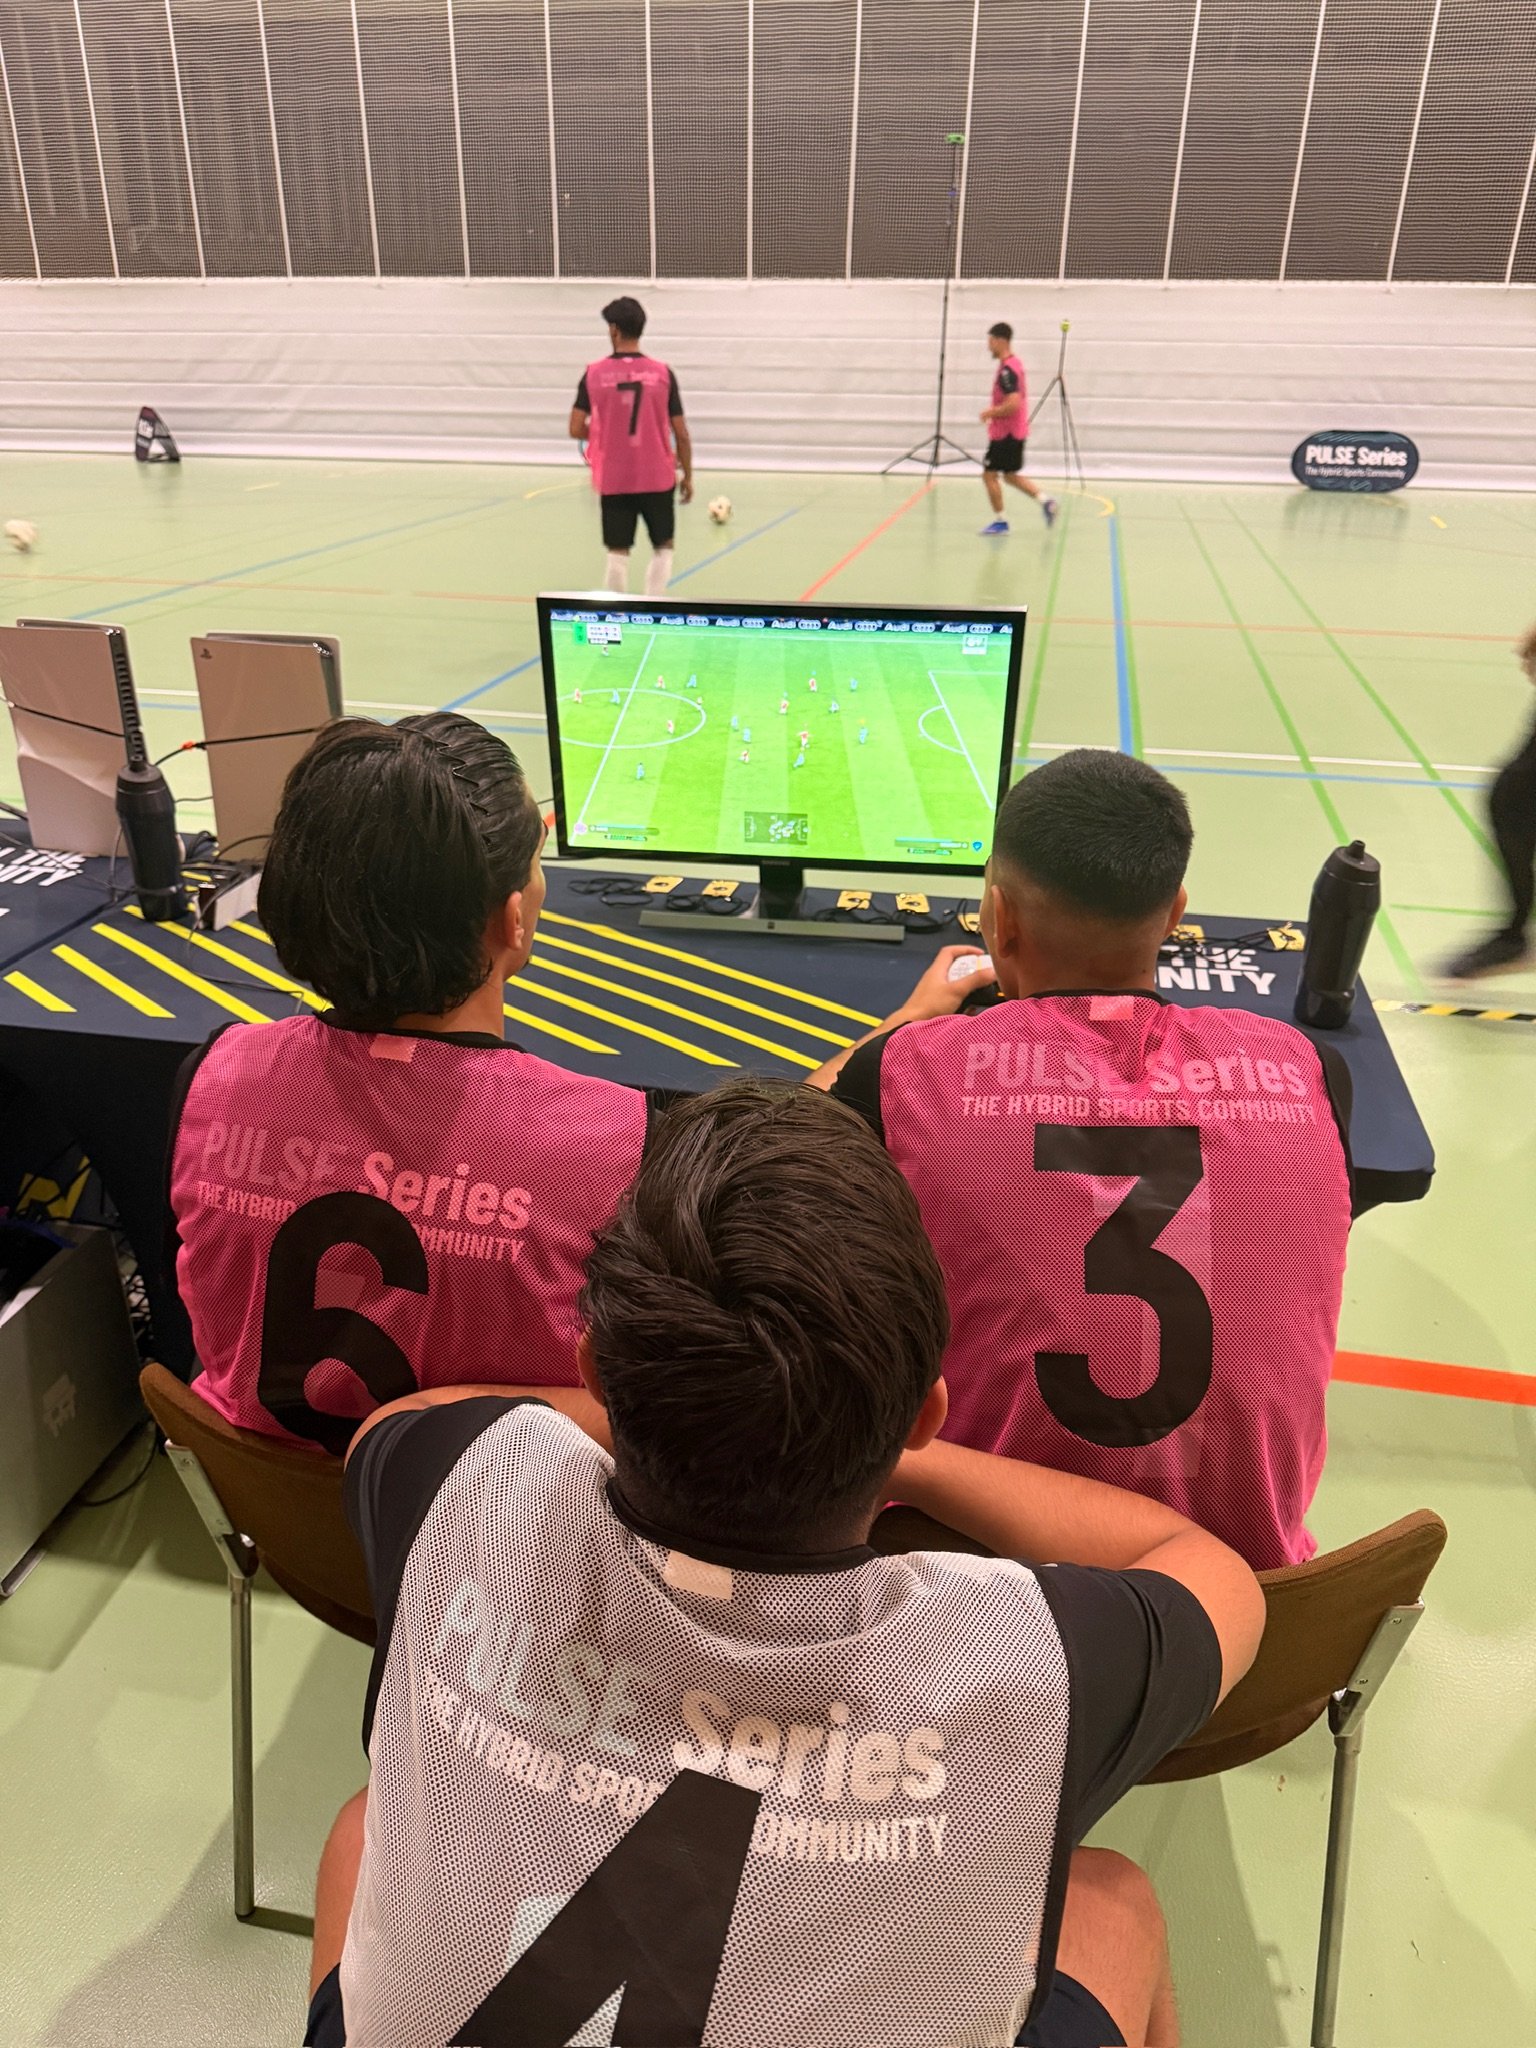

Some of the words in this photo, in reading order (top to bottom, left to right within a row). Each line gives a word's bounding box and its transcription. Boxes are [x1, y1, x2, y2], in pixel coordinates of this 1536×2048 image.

[617, 381, 644, 436] 7
[1305, 444, 1356, 466] PULSE
[1357, 446, 1408, 467] Series
[605, 613, 630, 623] Audi
[660, 615, 685, 625] Audi
[715, 617, 741, 627] Audi
[771, 619, 796, 629] Audi
[828, 621, 853, 631] Audi
[884, 622, 910, 632] Audi
[941, 623, 968, 634] Audi
[1154, 966, 1276, 995] NITY
[1146, 1049, 1308, 1097] Series
[961, 1096, 1000, 1117] THE
[1007, 1094, 1089, 1117] HYBRID
[1099, 1098, 1191, 1120] SPORTS
[1199, 1098, 1316, 1126] COMMUNITY
[197, 1180, 225, 1209] THE
[226, 1187, 299, 1222] HYBRID
[358, 1151, 533, 1230] Series
[1033, 1123, 1214, 1448] 3
[257, 1191, 429, 1457] 6
[671, 1688, 948, 1801] Series
[458, 1707, 566, 1792] HYBRID
[750, 1810, 948, 1863] OMMUNITY
[446, 1767, 763, 2048] 4
